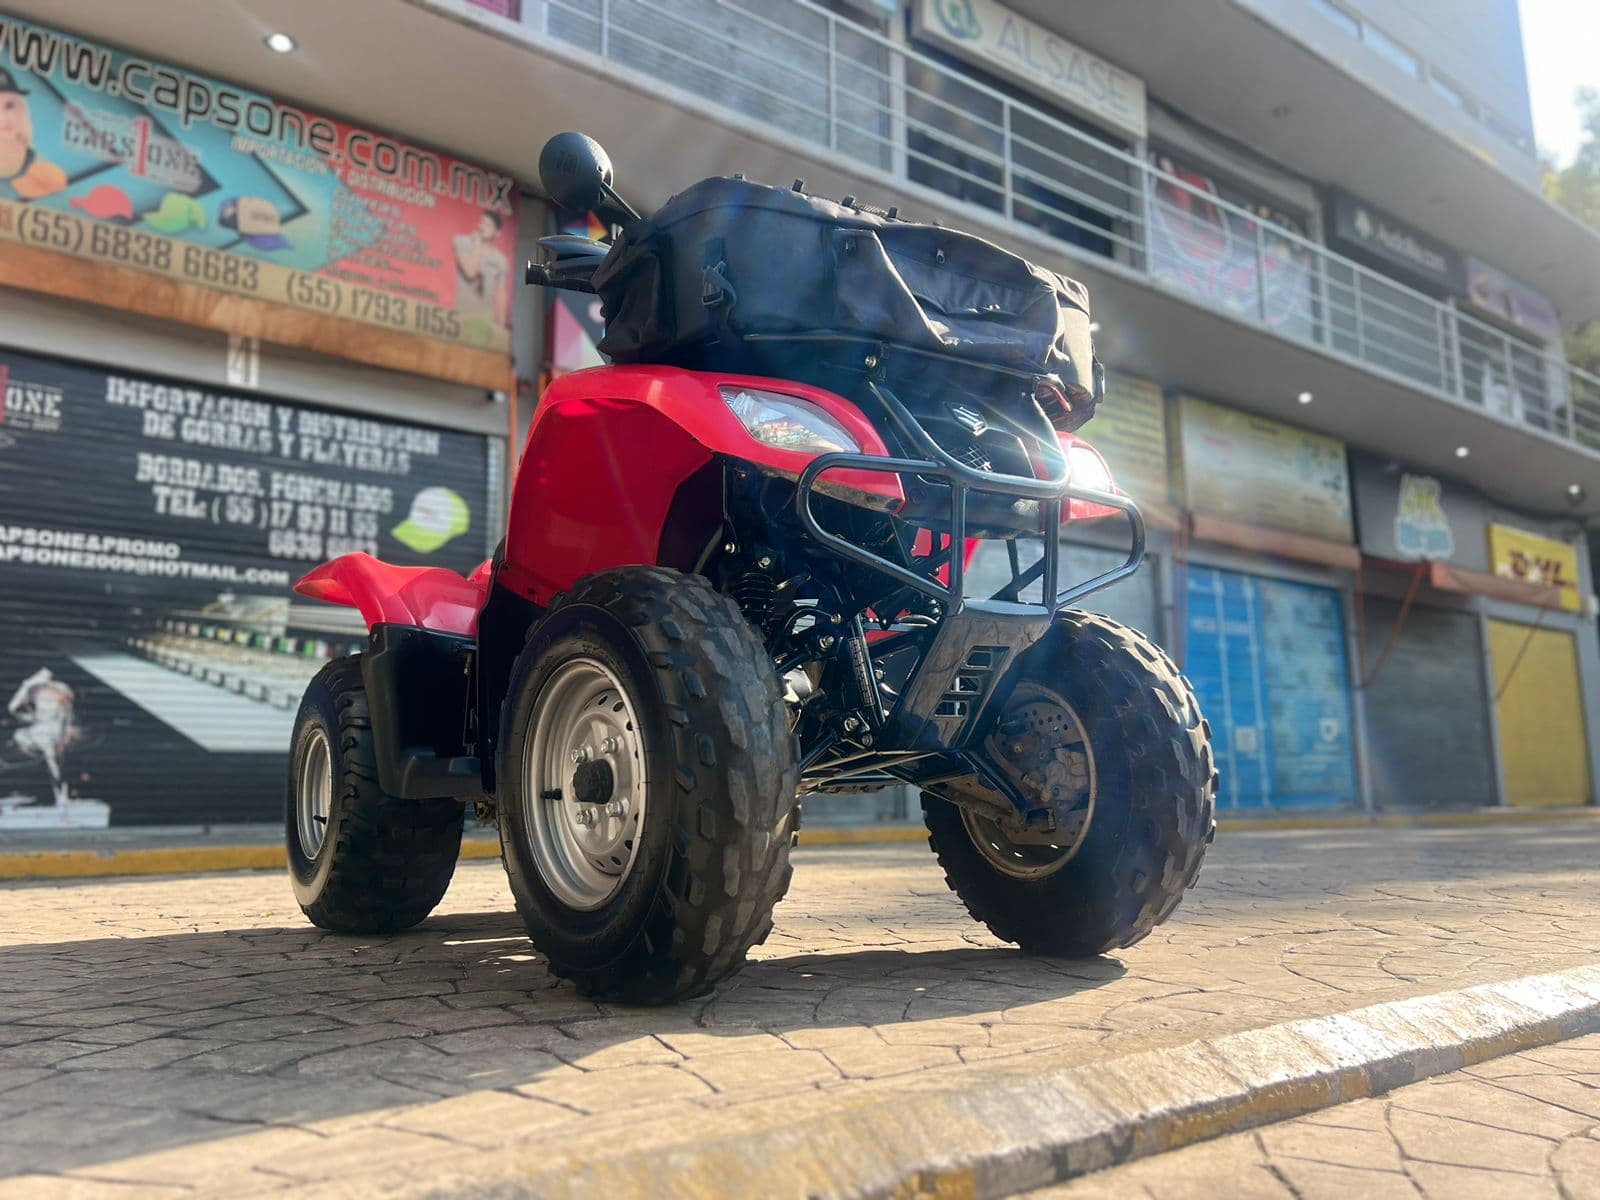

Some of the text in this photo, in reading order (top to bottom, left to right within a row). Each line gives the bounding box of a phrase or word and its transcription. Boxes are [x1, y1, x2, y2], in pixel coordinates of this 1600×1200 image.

[997, 16, 1129, 112] ALSASE
[0, 22, 512, 214] ww.capsone.com.mx
[17, 207, 84, 247] (55)
[91, 222, 172, 271] 6838
[183, 244, 259, 291] 6683
[286, 271, 341, 316] (55)
[351, 287, 407, 324] 1793
[414, 302, 461, 338] 1155
[105, 376, 272, 428] IMPORTACION
[276, 405, 294, 431] Y
[143, 410, 411, 476] DE GORRAS Y PLAYERAS
